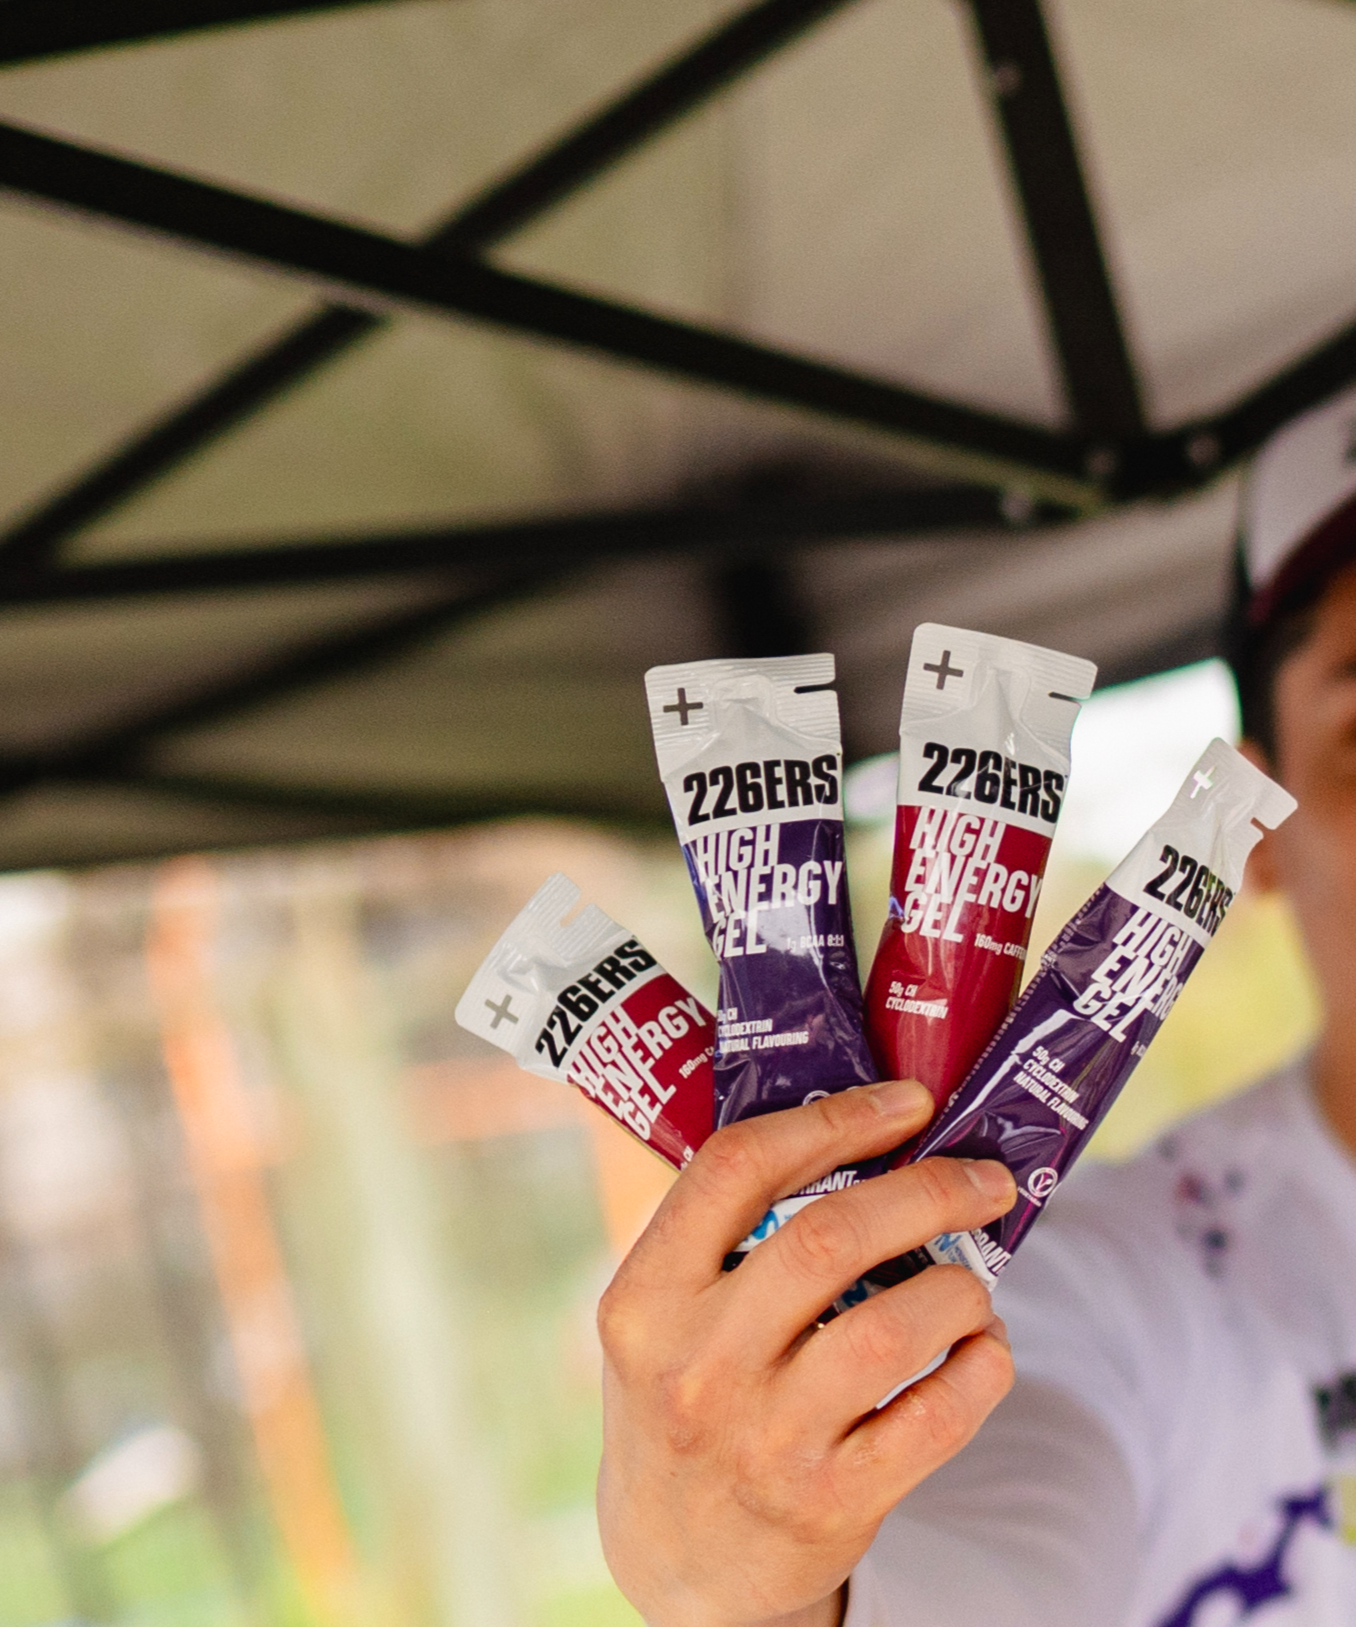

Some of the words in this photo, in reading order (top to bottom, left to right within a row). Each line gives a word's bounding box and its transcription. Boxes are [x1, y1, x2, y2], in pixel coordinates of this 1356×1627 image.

[683, 755, 839, 826] 226ERS
[917, 742, 1064, 823] 226ERS
[696, 823, 780, 880] HIGH
[909, 806, 1006, 864] HIGH
[706, 861, 843, 924] ENERGY
[900, 892, 964, 943] GEL
[904, 849, 1043, 918] ENERGY
[1142, 844, 1235, 938] 226ERS
[713, 907, 767, 957] GEL
[1112, 907, 1193, 976] HIGH
[535, 937, 657, 1068] 226ERS
[1073, 982, 1151, 1043] GEL
[1091, 944, 1184, 1021] ENERG
[567, 1003, 640, 1098] HIGH
[590, 995, 707, 1121] ENERGY
[621, 1065, 677, 1141] GEL
